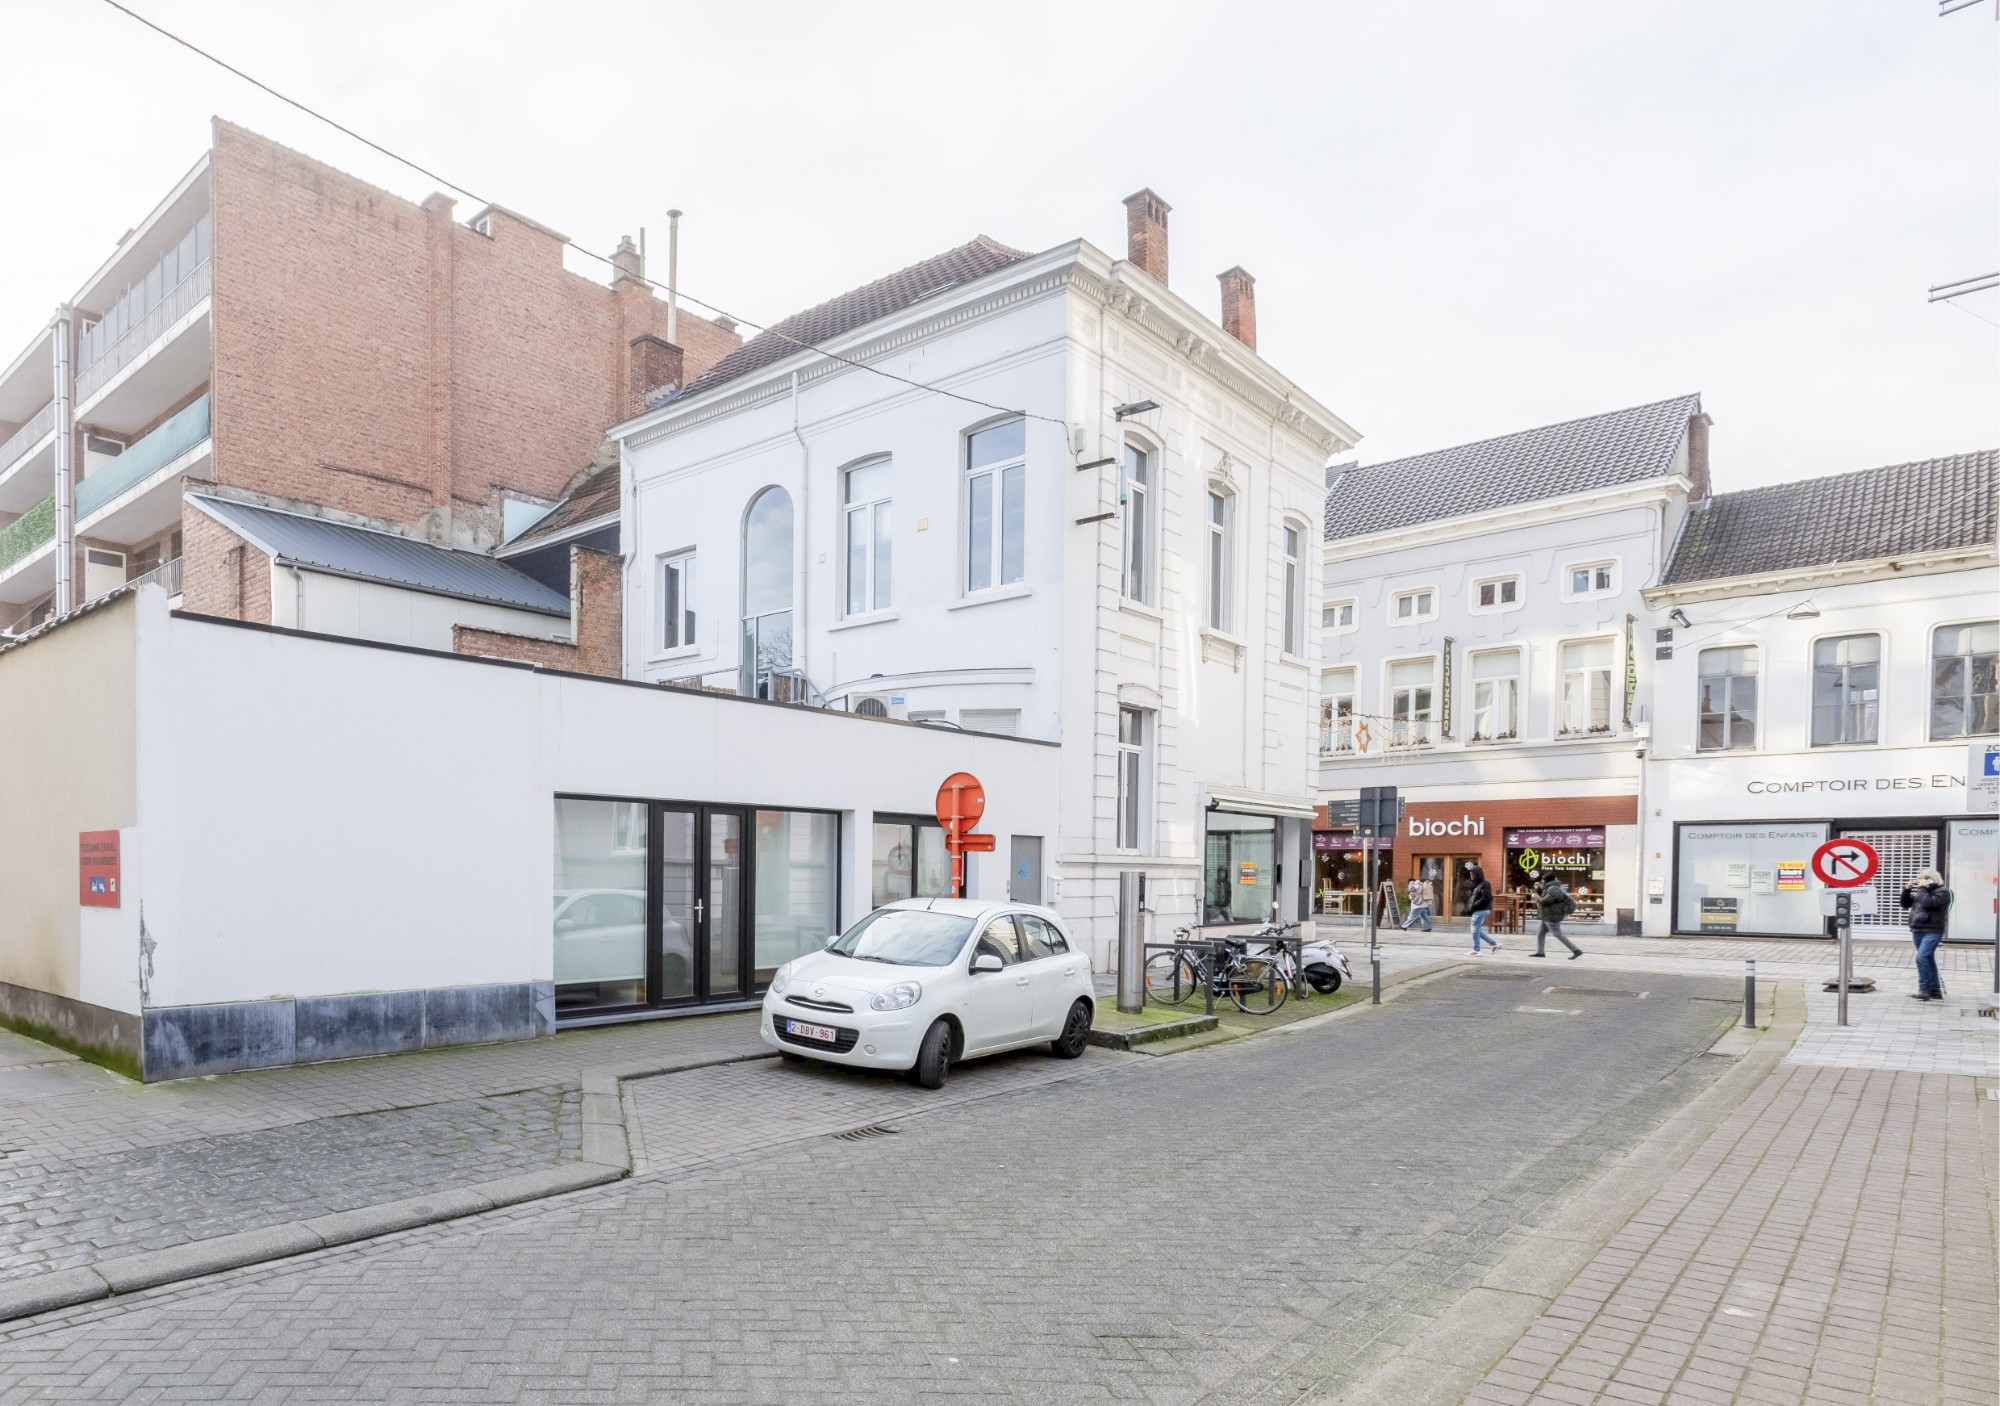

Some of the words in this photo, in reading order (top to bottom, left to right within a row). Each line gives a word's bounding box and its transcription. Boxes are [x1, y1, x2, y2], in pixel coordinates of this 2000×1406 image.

[1747, 779, 1868, 794] COMPTOIR
[1875, 777, 1922, 790] DES
[1409, 815, 1484, 837] biochi
[1688, 832, 1742, 840] COMPTOIR
[1768, 830, 1818, 839] ENFANTS
[1541, 852, 1591, 864] biochi
[791, 1023, 834, 1040] 2-DBV-961
